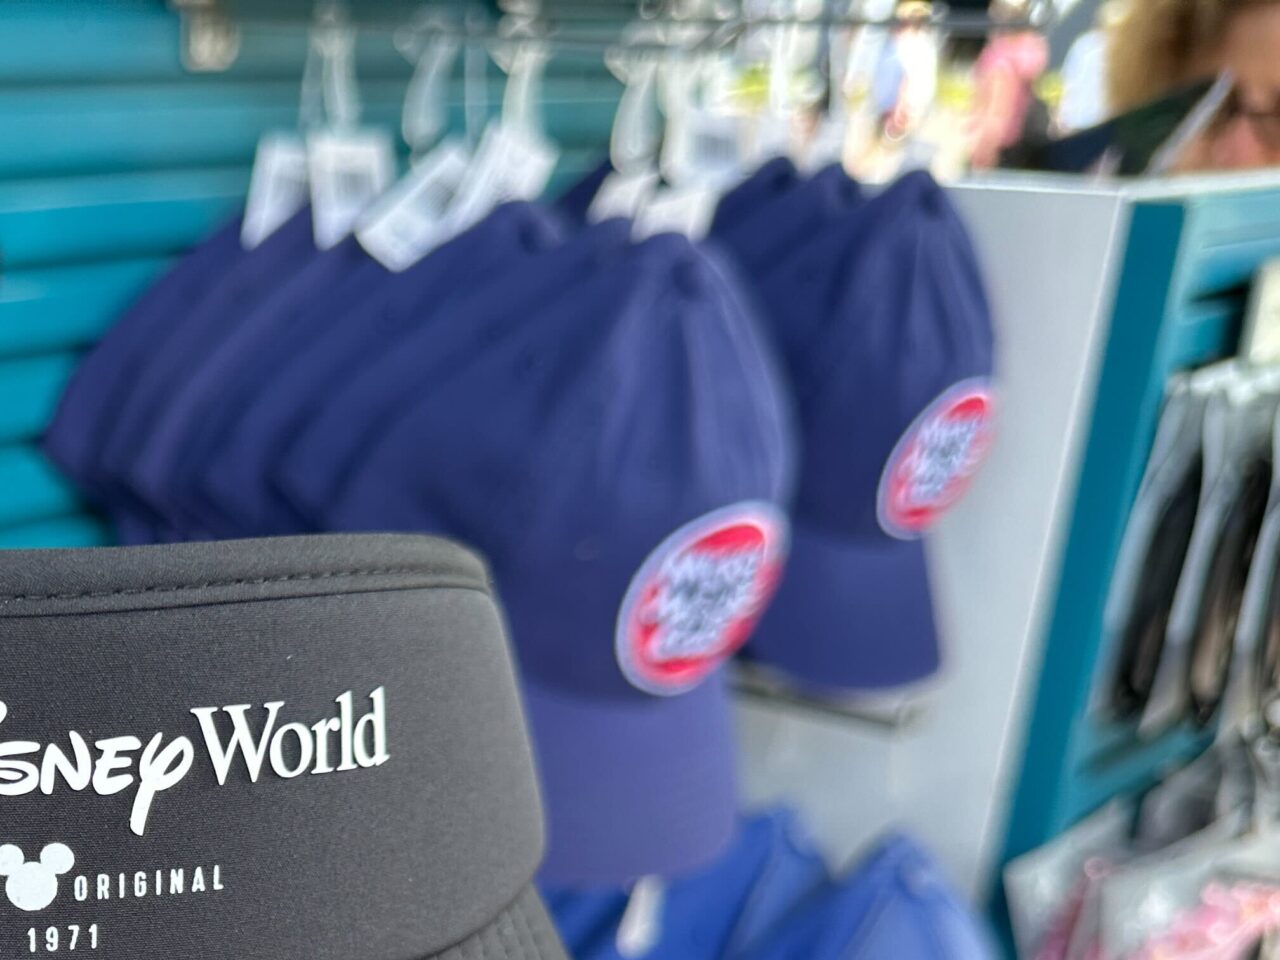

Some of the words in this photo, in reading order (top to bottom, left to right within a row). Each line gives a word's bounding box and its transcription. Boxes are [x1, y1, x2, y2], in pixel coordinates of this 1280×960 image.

[189, 685, 393, 786] World
[73, 863, 226, 903] ORIGINAL
[27, 922, 100, 954] 1971
